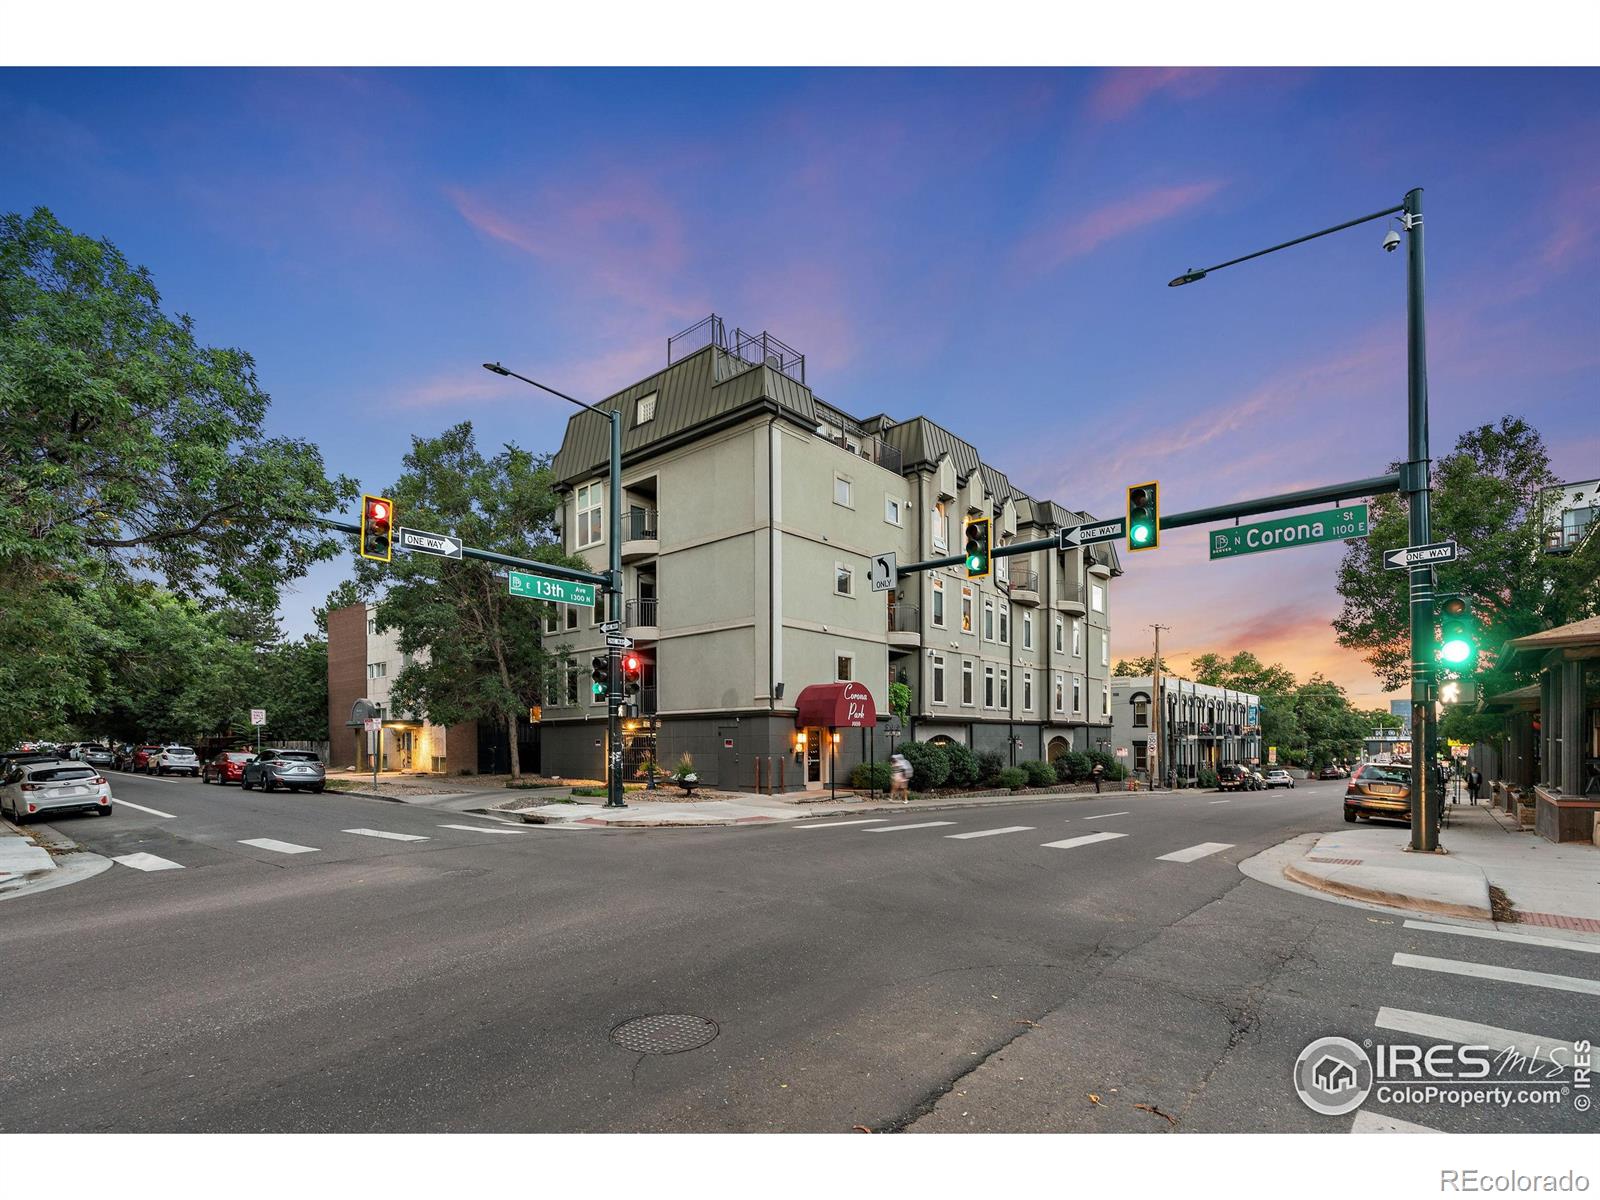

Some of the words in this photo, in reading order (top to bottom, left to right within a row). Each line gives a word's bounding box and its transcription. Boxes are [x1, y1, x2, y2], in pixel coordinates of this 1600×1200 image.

[1080, 530, 1097, 539] ONE
[1099, 526, 1116, 535] WAY
[1234, 536, 1241, 545] N
[1246, 521, 1324, 547] Corona
[1343, 511, 1354, 521] St
[1332, 523, 1355, 535] 1100
[1358, 522, 1365, 532] E
[407, 535, 425, 546] ONE
[427, 539, 443, 549] WAY
[1406, 551, 1425, 561] ONE
[1429, 547, 1449, 558] WAY
[536, 580, 564, 598] 13th
[575, 586, 586, 594] Ave
[876, 579, 892, 589] ONLY
[570, 593, 585, 602] 1300
[843, 683, 868, 701] Corona
[847, 702, 865, 720] Park
